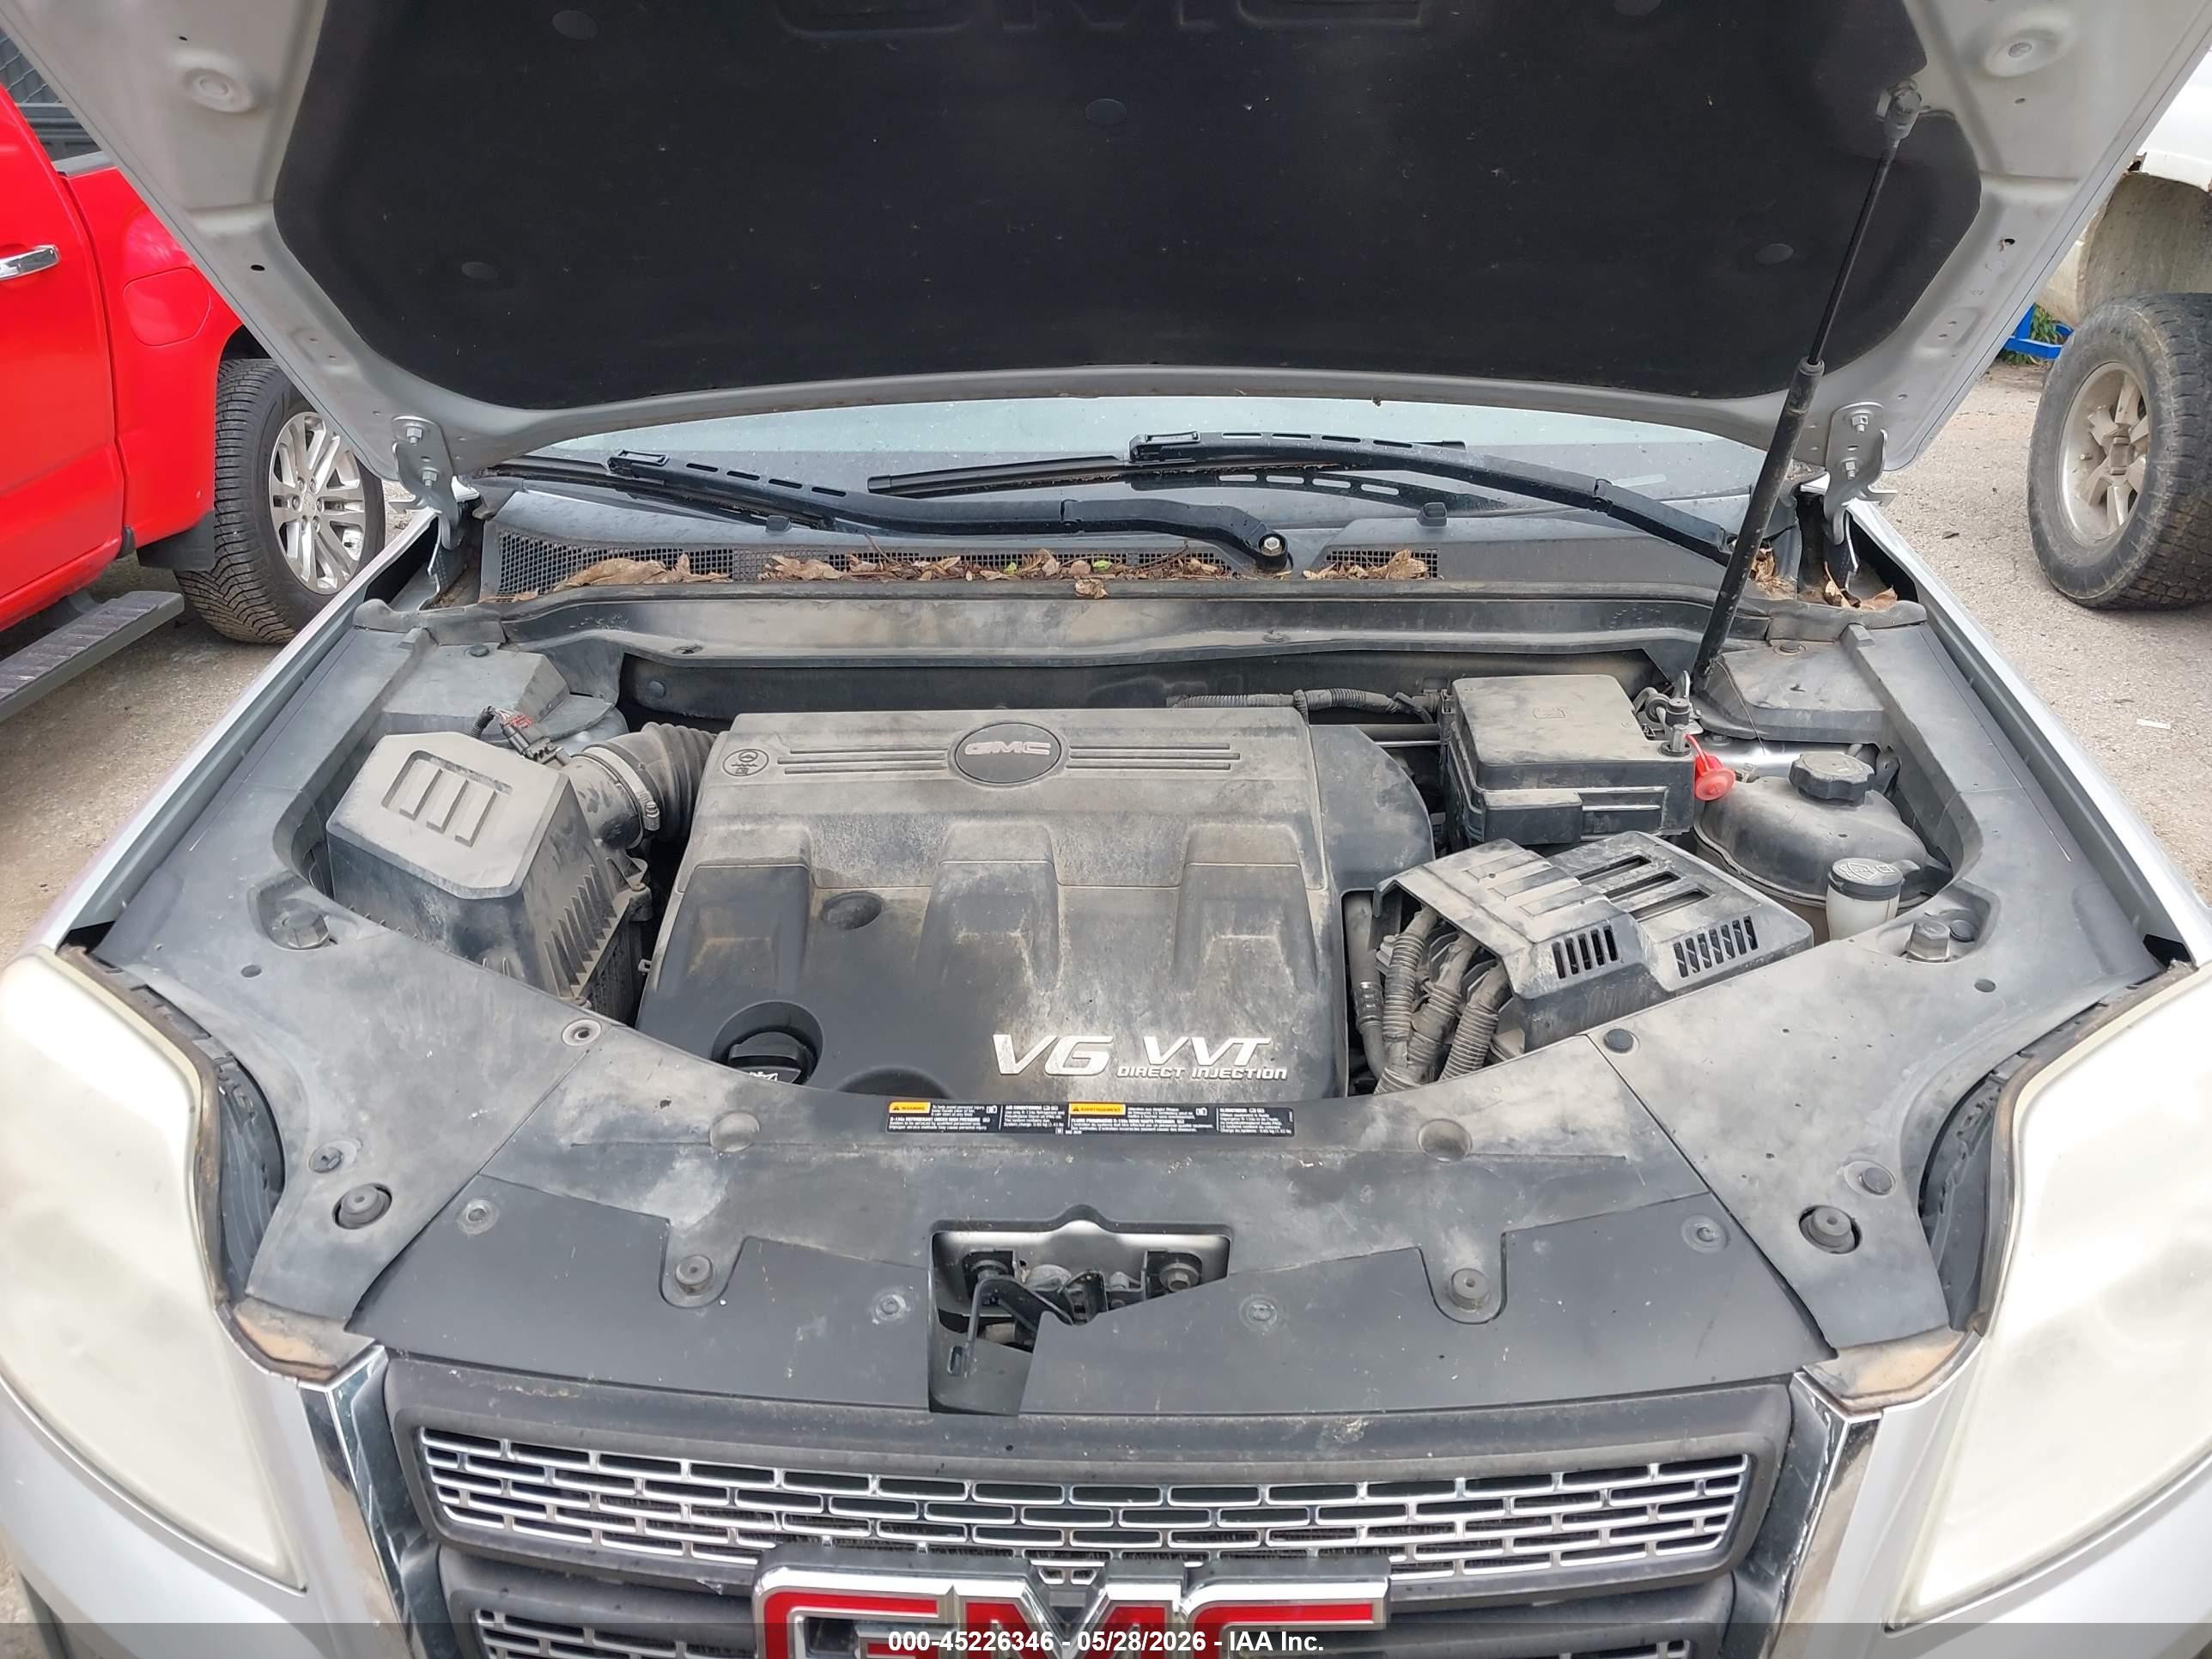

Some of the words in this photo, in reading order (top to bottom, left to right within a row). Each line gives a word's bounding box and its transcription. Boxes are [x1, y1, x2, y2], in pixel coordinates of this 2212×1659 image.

[964, 740, 1052, 756] GMC
[993, 1034, 1114, 1076] V6
[1143, 1036, 1272, 1066] VVT
[1116, 1066, 1185, 1079] DIRECT
[1191, 1066, 1287, 1080] INJECTION
